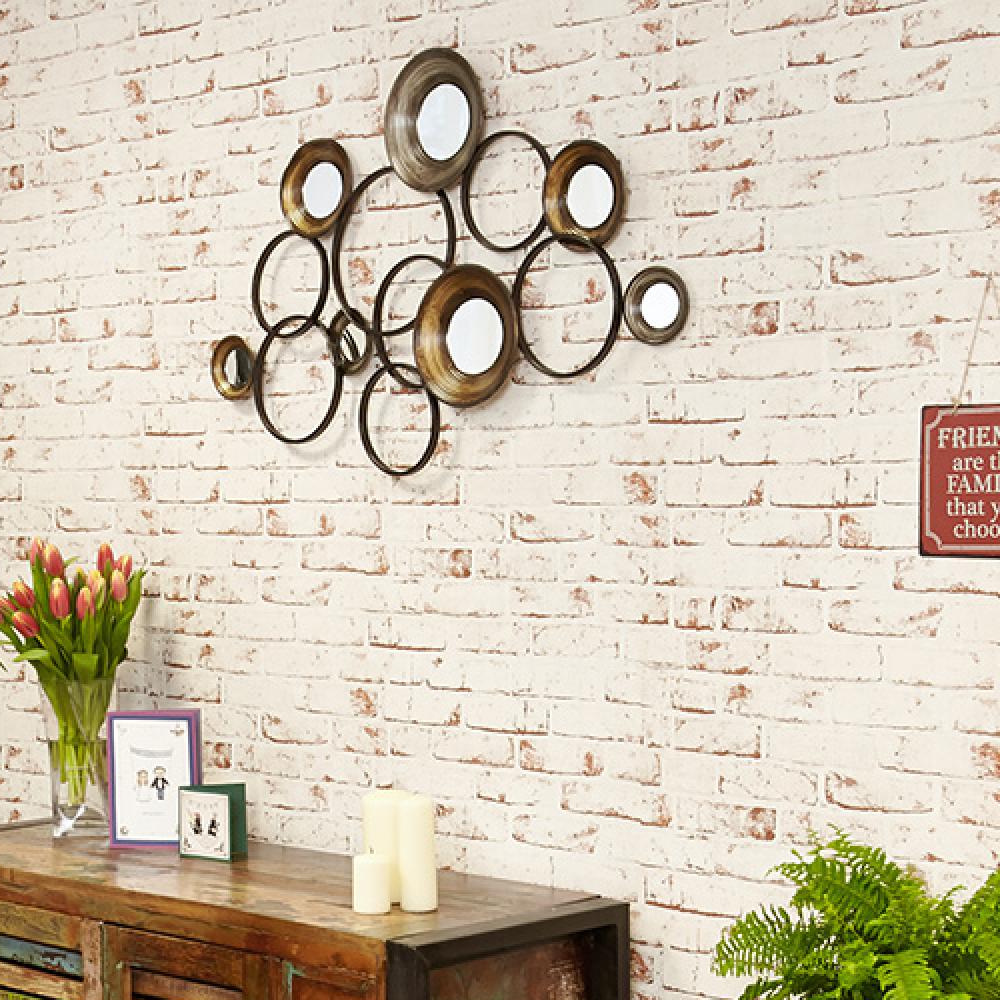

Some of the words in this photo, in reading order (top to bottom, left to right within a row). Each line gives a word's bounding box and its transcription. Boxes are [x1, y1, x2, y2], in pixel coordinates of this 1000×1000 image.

[952, 457, 984, 471] are
[946, 496, 985, 516] that
[953, 518, 1000, 539] choo
